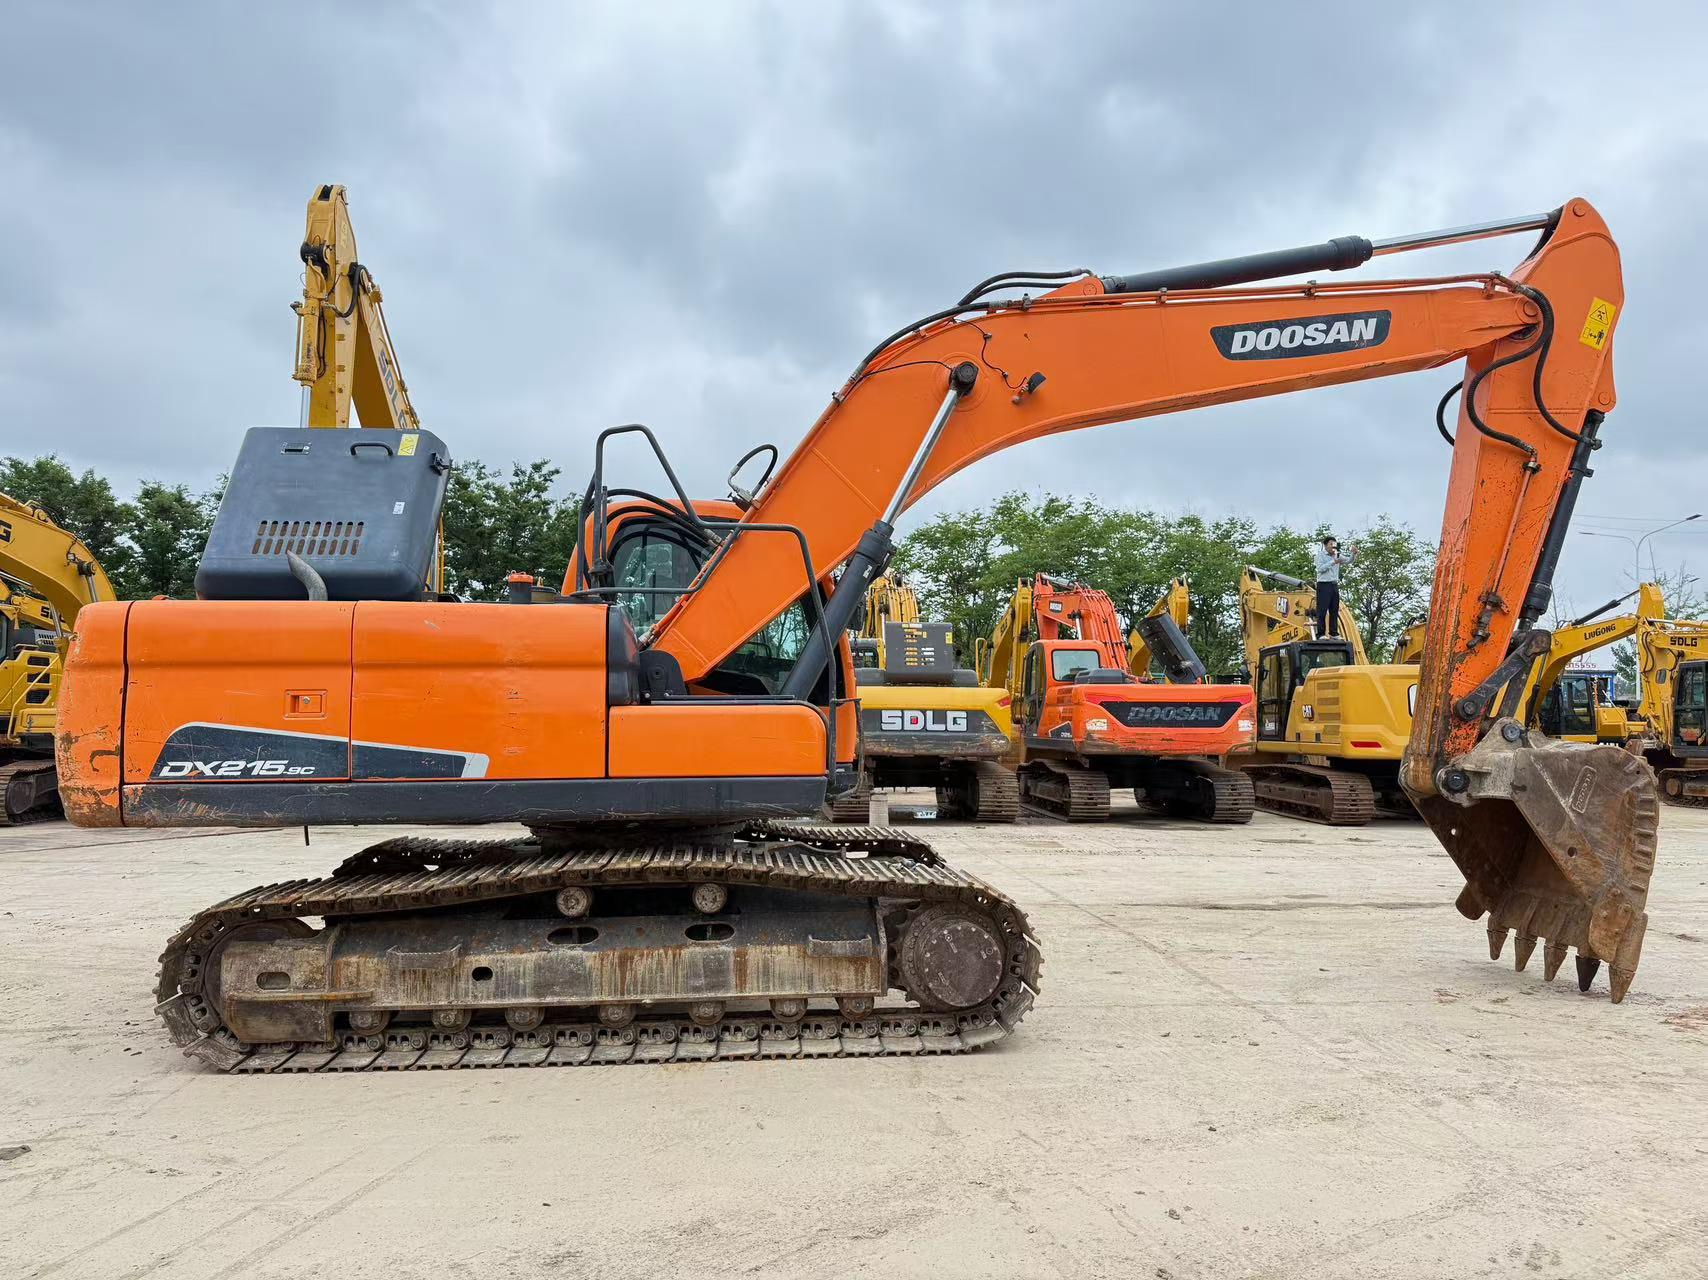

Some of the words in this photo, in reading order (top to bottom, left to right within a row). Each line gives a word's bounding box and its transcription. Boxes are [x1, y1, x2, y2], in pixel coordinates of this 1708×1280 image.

[1230, 318, 1377, 354] DOOSAN
[1276, 596, 1288, 614] CAT
[1670, 636, 1698, 647] SDLG
[1127, 706, 1220, 721] DOOSAN
[1302, 704, 1313, 718] CAT
[881, 709, 967, 732] SDLG
